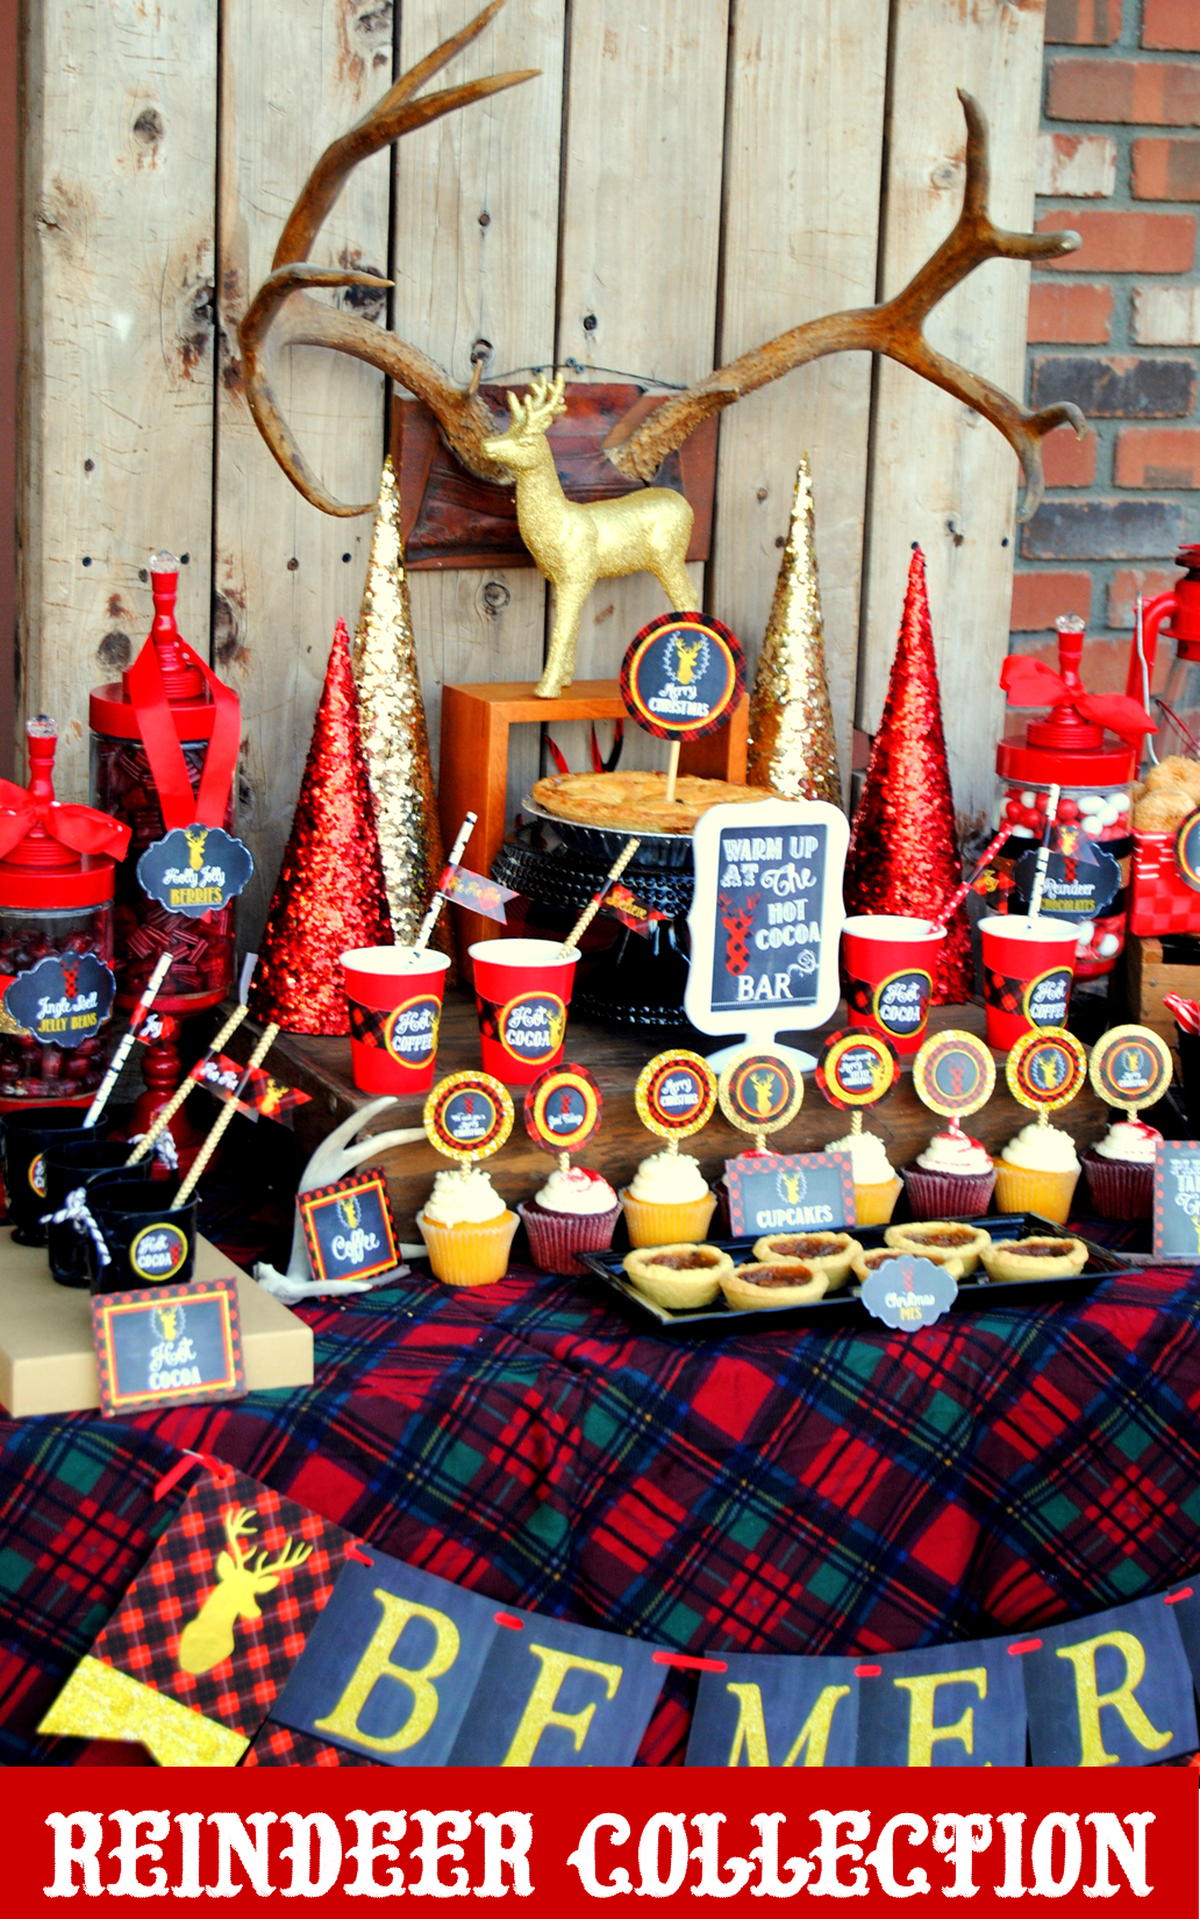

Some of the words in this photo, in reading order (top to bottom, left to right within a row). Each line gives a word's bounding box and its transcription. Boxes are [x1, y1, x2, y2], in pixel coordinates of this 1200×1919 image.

[660, 682, 698, 701] Merry
[648, 697, 710, 718] CHRISTMAS
[722, 837, 783, 862] WARM
[790, 835, 819, 859] UP
[720, 863, 759, 888] AT
[760, 862, 817, 896] The
[1042, 877, 1095, 900] Reindeer
[170, 887, 223, 905] BERRIES
[767, 898, 809, 925] HOT
[755, 921, 821, 950] COCOA
[736, 972, 793, 1000] BAR
[884, 981, 920, 1005] Hot
[1034, 979, 1067, 1004] Hot
[394, 1008, 432, 1035] Hot
[508, 1004, 547, 1030] Hot
[879, 1003, 921, 1022] COCOA
[1029, 1002, 1065, 1019] COFFEE
[37, 1017, 68, 1033] JELLY
[71, 1012, 97, 1030] BEANS
[392, 1033, 433, 1052] COFFEE
[506, 1029, 551, 1048] COCOA
[756, 1205, 833, 1228] CUPCAKES
[137, 1234, 170, 1255] Hot
[331, 1228, 380, 1264] Coffee
[137, 1252, 173, 1268] COCOA
[149, 1336, 197, 1371] Hot
[148, 1365, 201, 1390] COCOA
